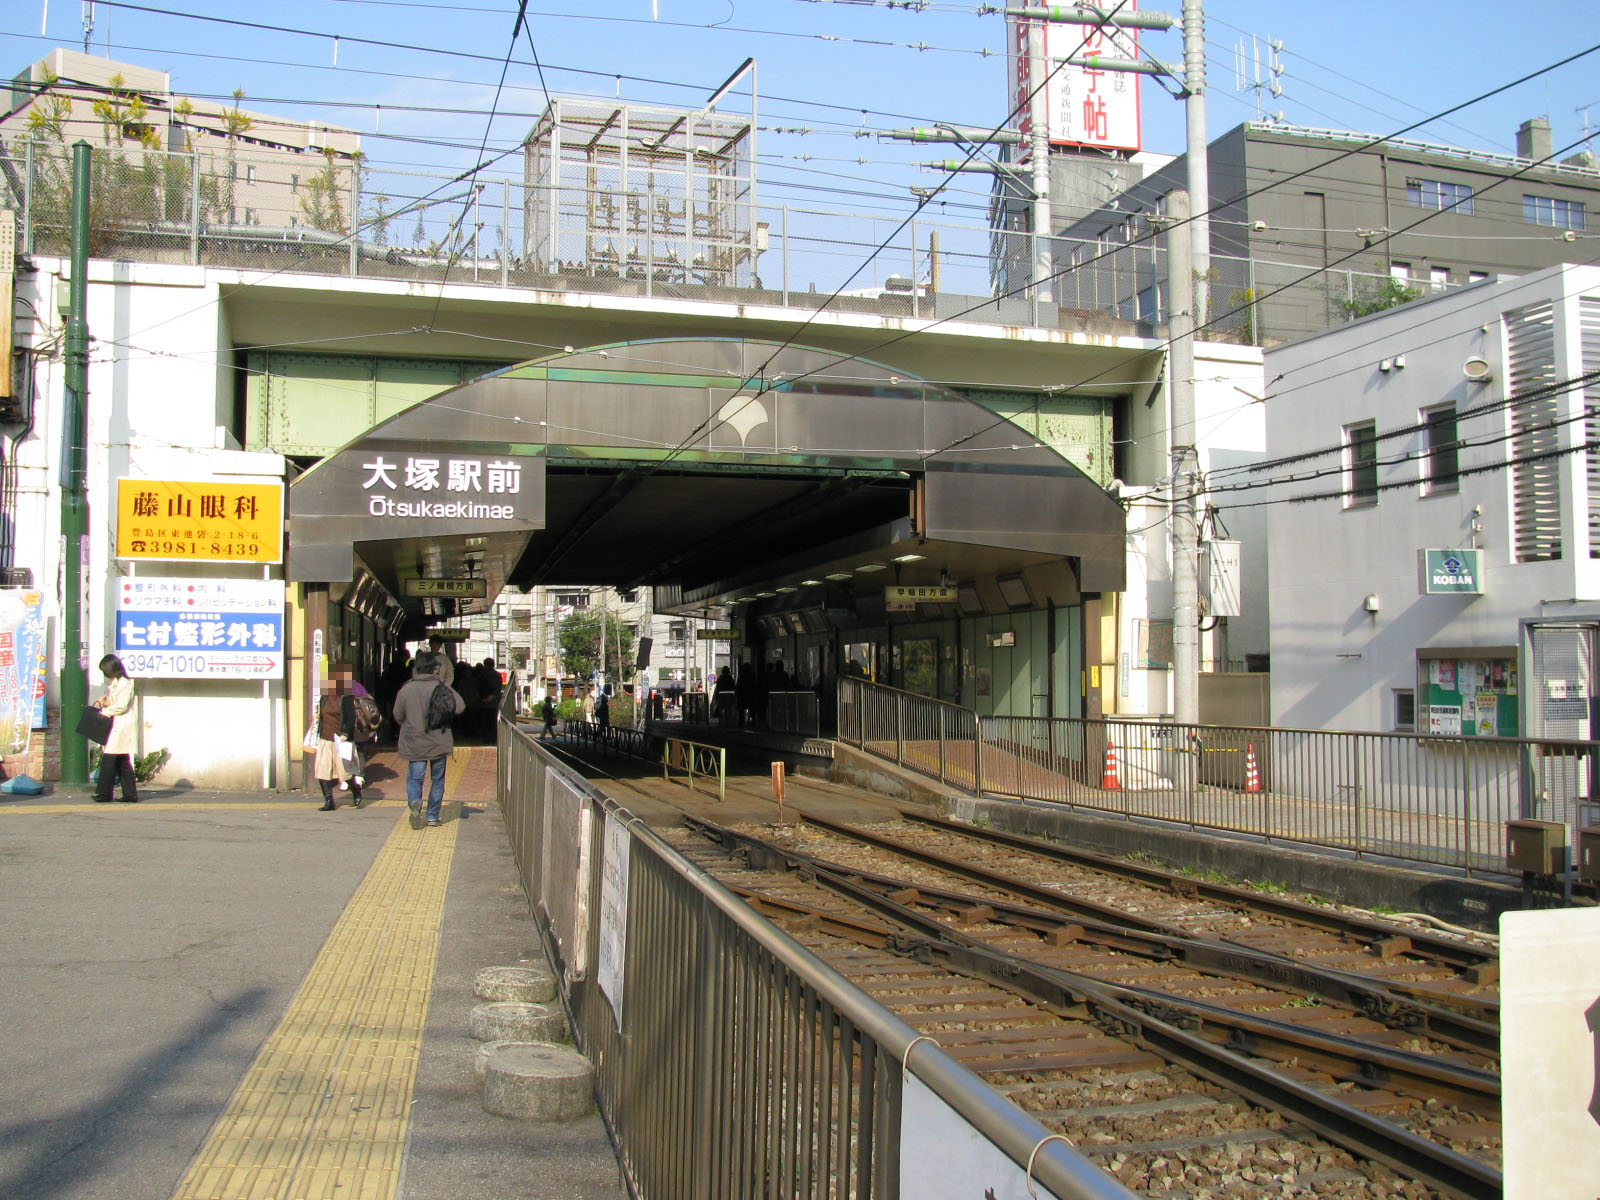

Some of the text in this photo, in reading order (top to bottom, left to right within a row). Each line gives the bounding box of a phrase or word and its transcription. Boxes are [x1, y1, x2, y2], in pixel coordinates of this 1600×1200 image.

[362, 457, 521, 494] 大塚駅前
[132, 492, 258, 520] 藤山眼科
[150, 541, 258, 555] 3981-8439
[135, 583, 181, 593] 整形外科
[1433, 575, 1473, 585] KOBAN
[121, 620, 278, 648] 七村整形外科
[127, 654, 205, 673] 3947-1010
